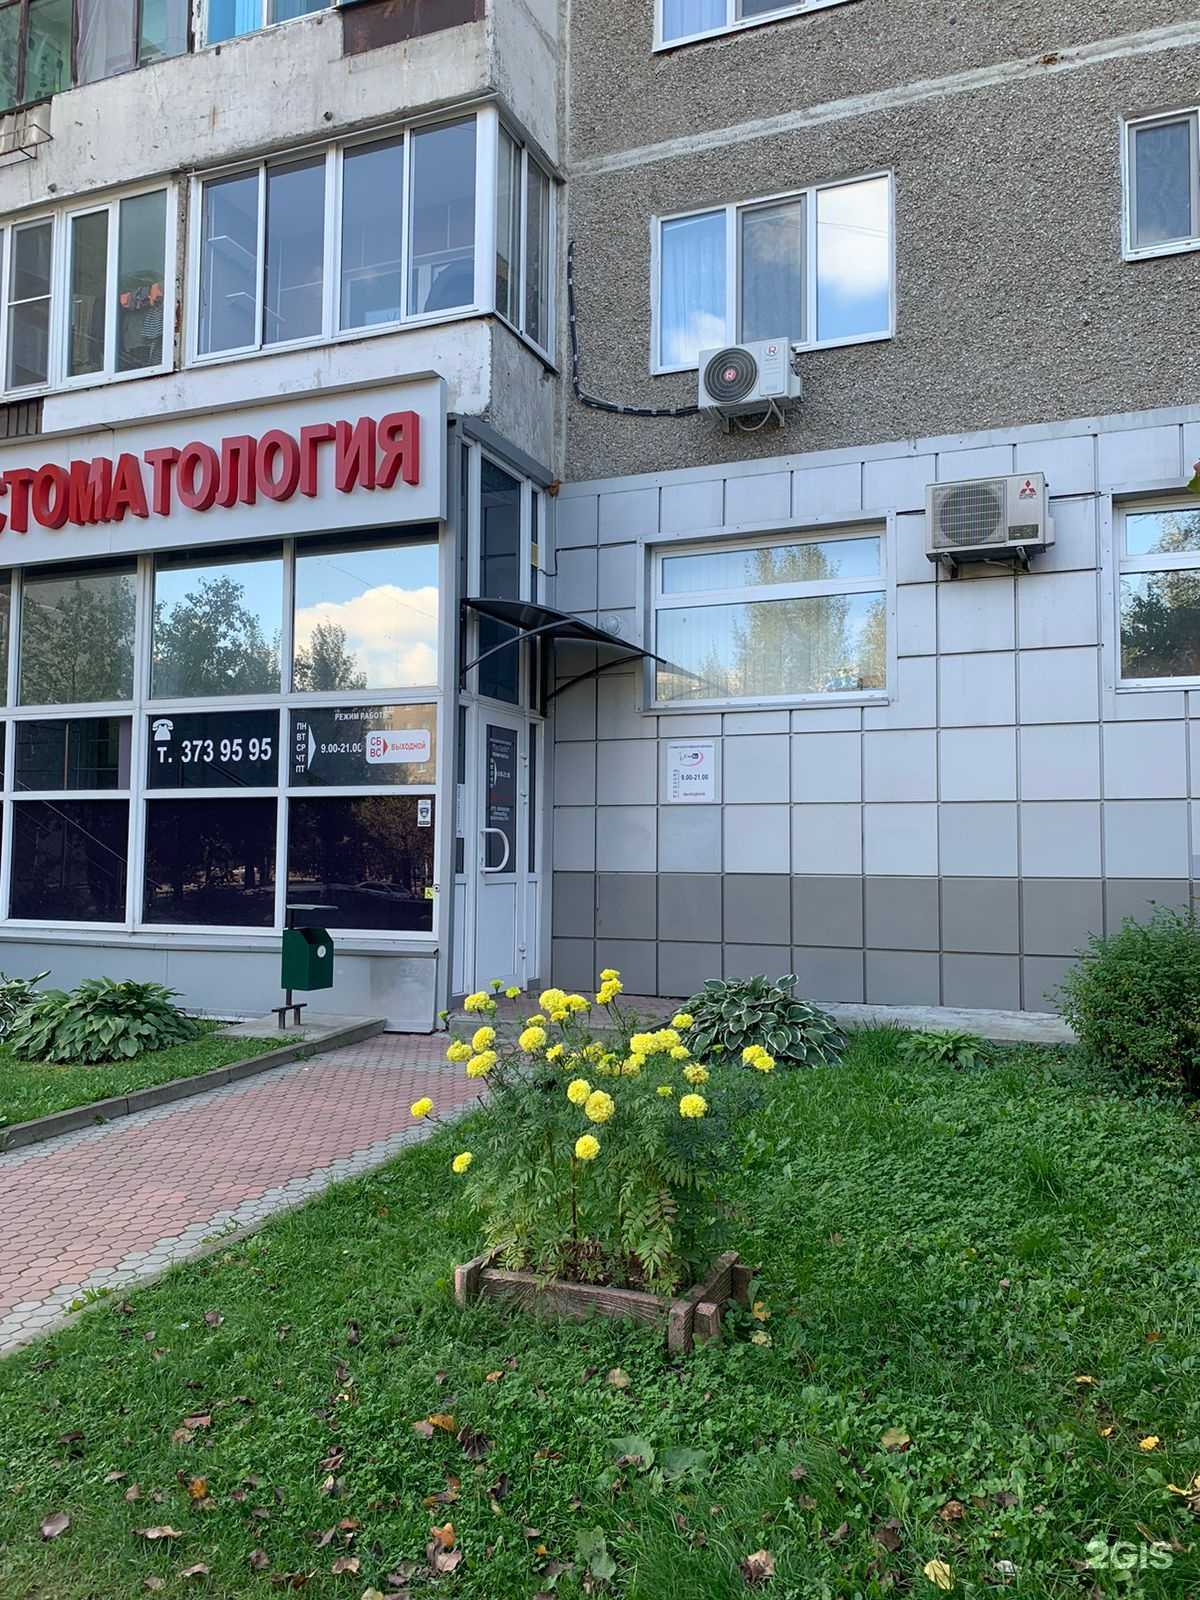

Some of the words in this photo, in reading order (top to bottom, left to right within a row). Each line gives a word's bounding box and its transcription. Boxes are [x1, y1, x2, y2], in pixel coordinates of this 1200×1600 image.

[334, 712, 359, 721] РЕЖИМ
[296, 722, 307, 730] ПН
[296, 733, 306, 741] ВТ
[370, 736, 382, 746] СБ
[181, 739, 214, 763] 373
[220, 738, 243, 762] 95
[248, 737, 272, 761] 95
[296, 744, 306, 752] СР
[320, 743, 362, 753] 9.00-21.00
[391, 740, 426, 751] ВЫХОДНОЙ
[370, 748, 382, 758] ВС
[296, 754, 306, 762] ЧТ
[295, 765, 305, 773] ПТ
